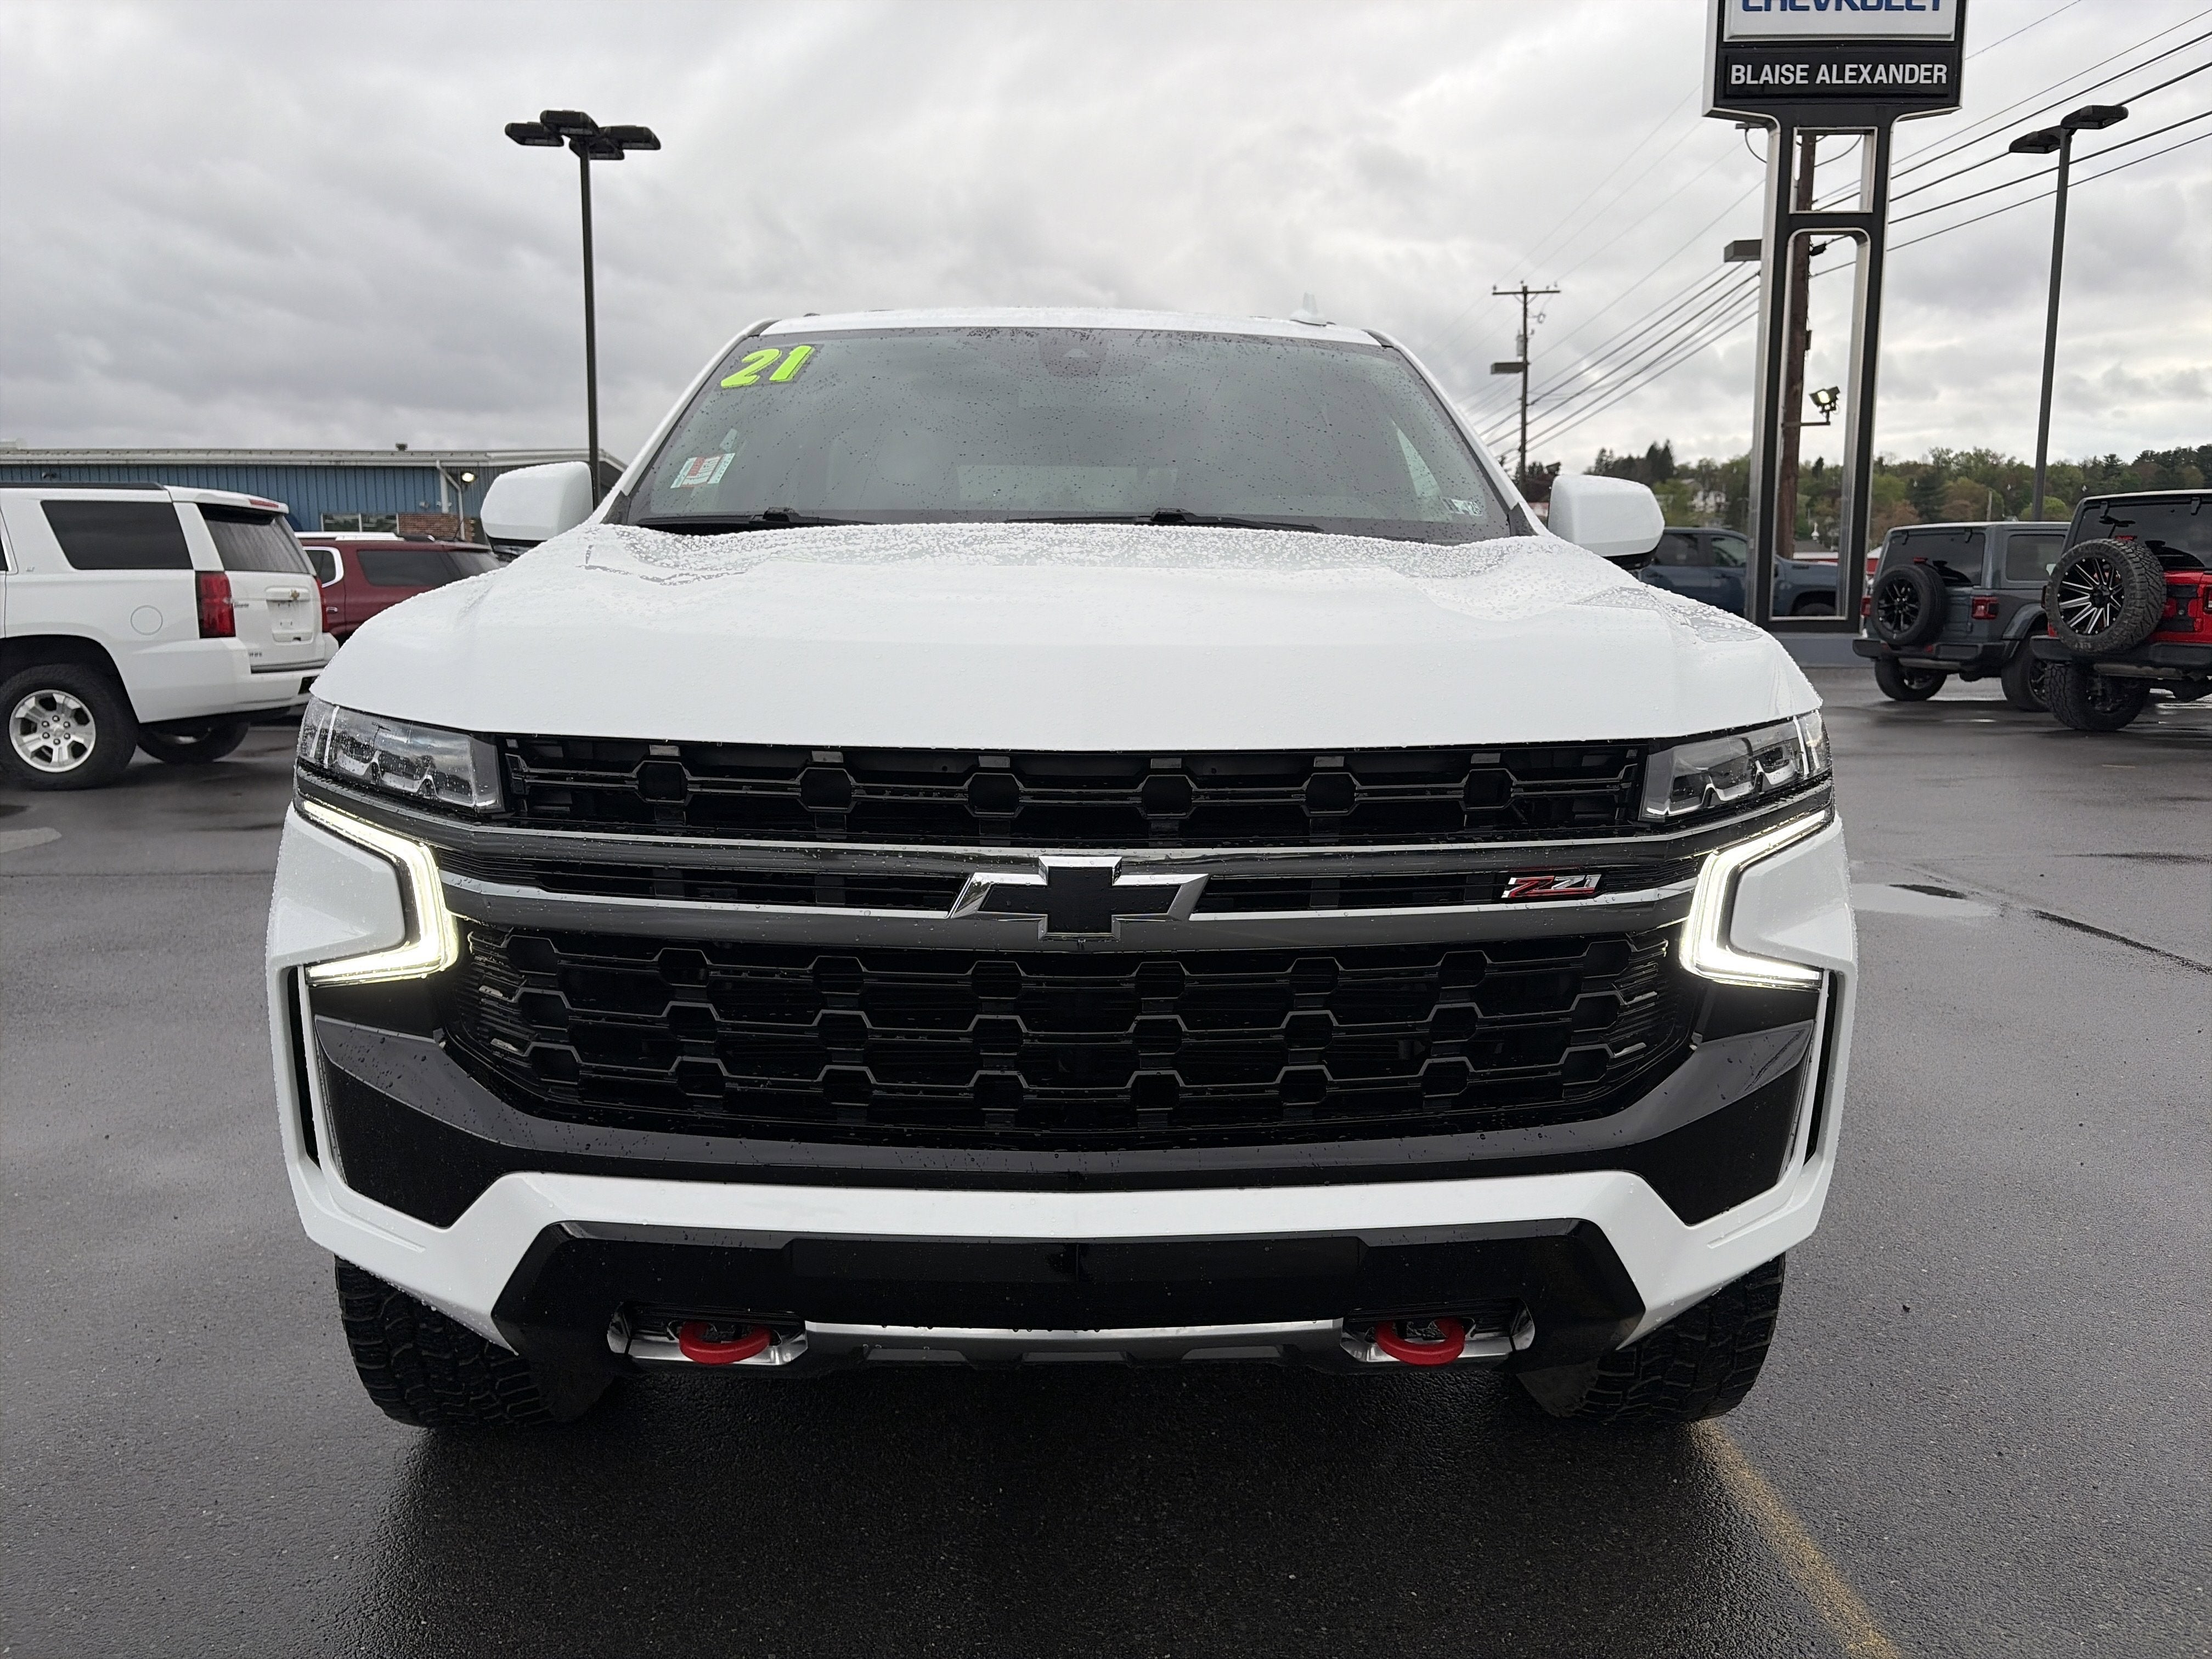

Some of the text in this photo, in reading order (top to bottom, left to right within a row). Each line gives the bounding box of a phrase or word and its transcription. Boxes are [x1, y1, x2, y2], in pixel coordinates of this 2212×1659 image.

[1730, 64, 1948, 84] BLAISE ALEXANDER
[720, 345, 816, 388] 21
[1501, 874, 1602, 899] Z71
